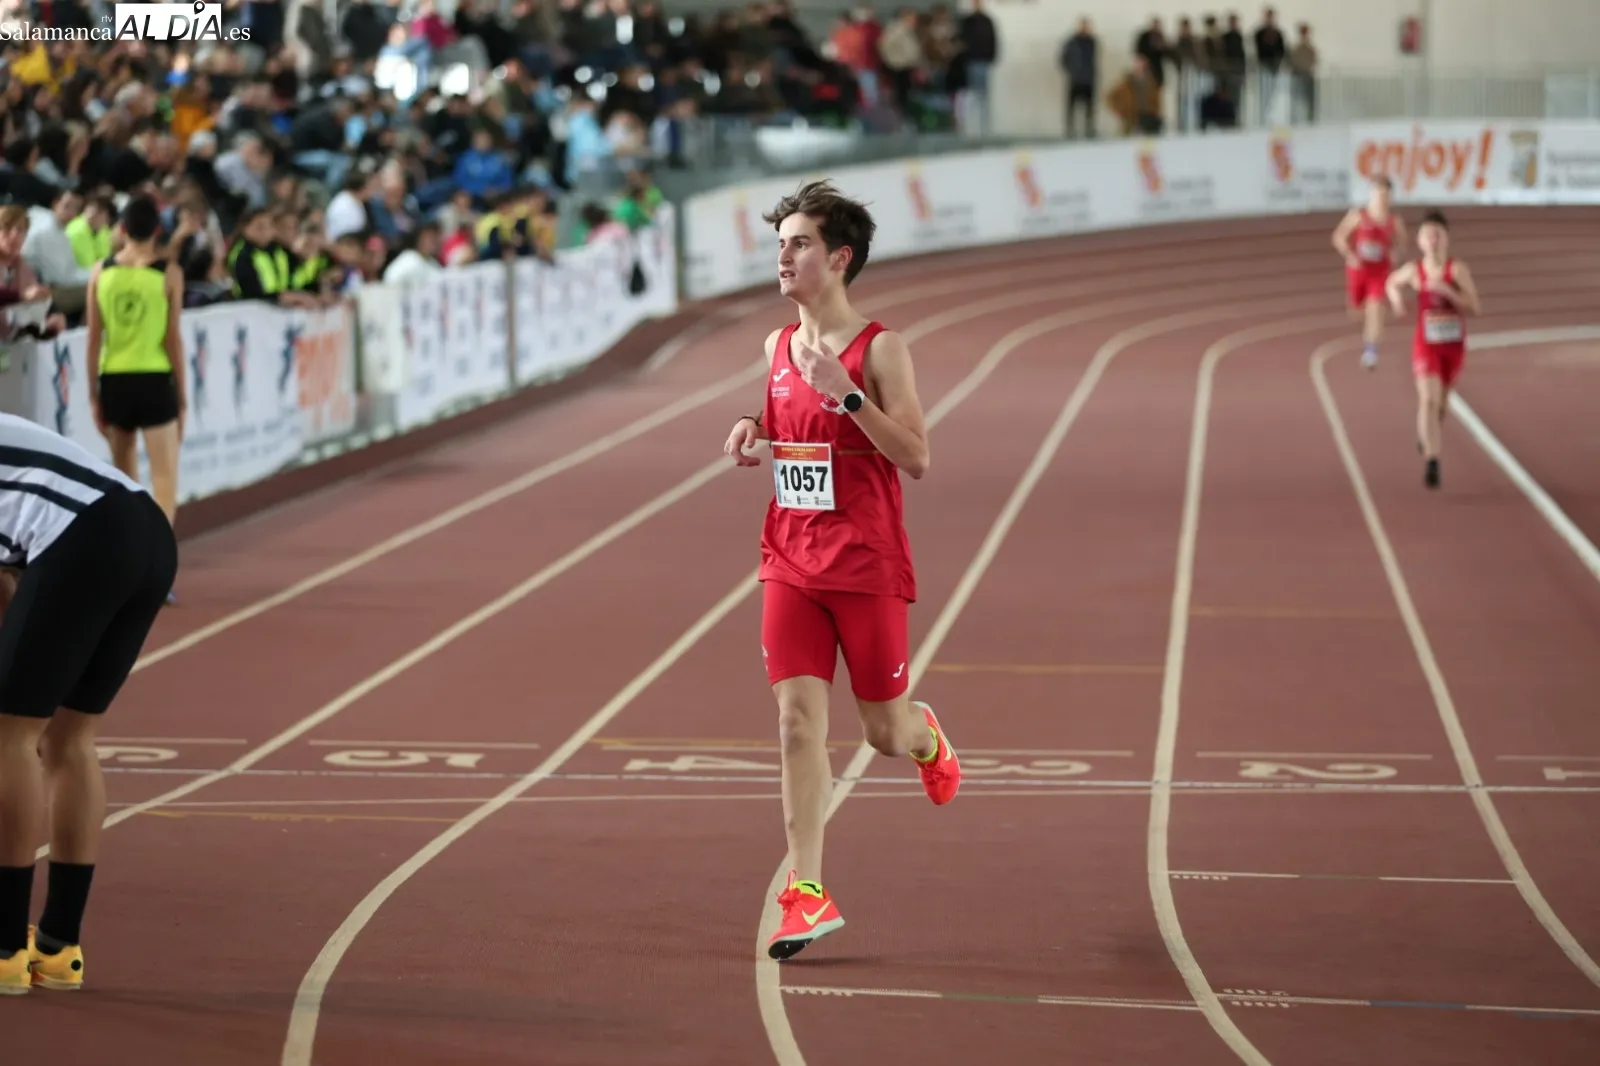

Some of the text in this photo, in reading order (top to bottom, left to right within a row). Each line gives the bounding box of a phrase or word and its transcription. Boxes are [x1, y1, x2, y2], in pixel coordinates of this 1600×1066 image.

[1356, 124, 1494, 191] enjoy!
[780, 464, 828, 492] 1057
[323, 749, 484, 769] 5
[624, 755, 781, 771] 4
[1239, 760, 1397, 780] 2
